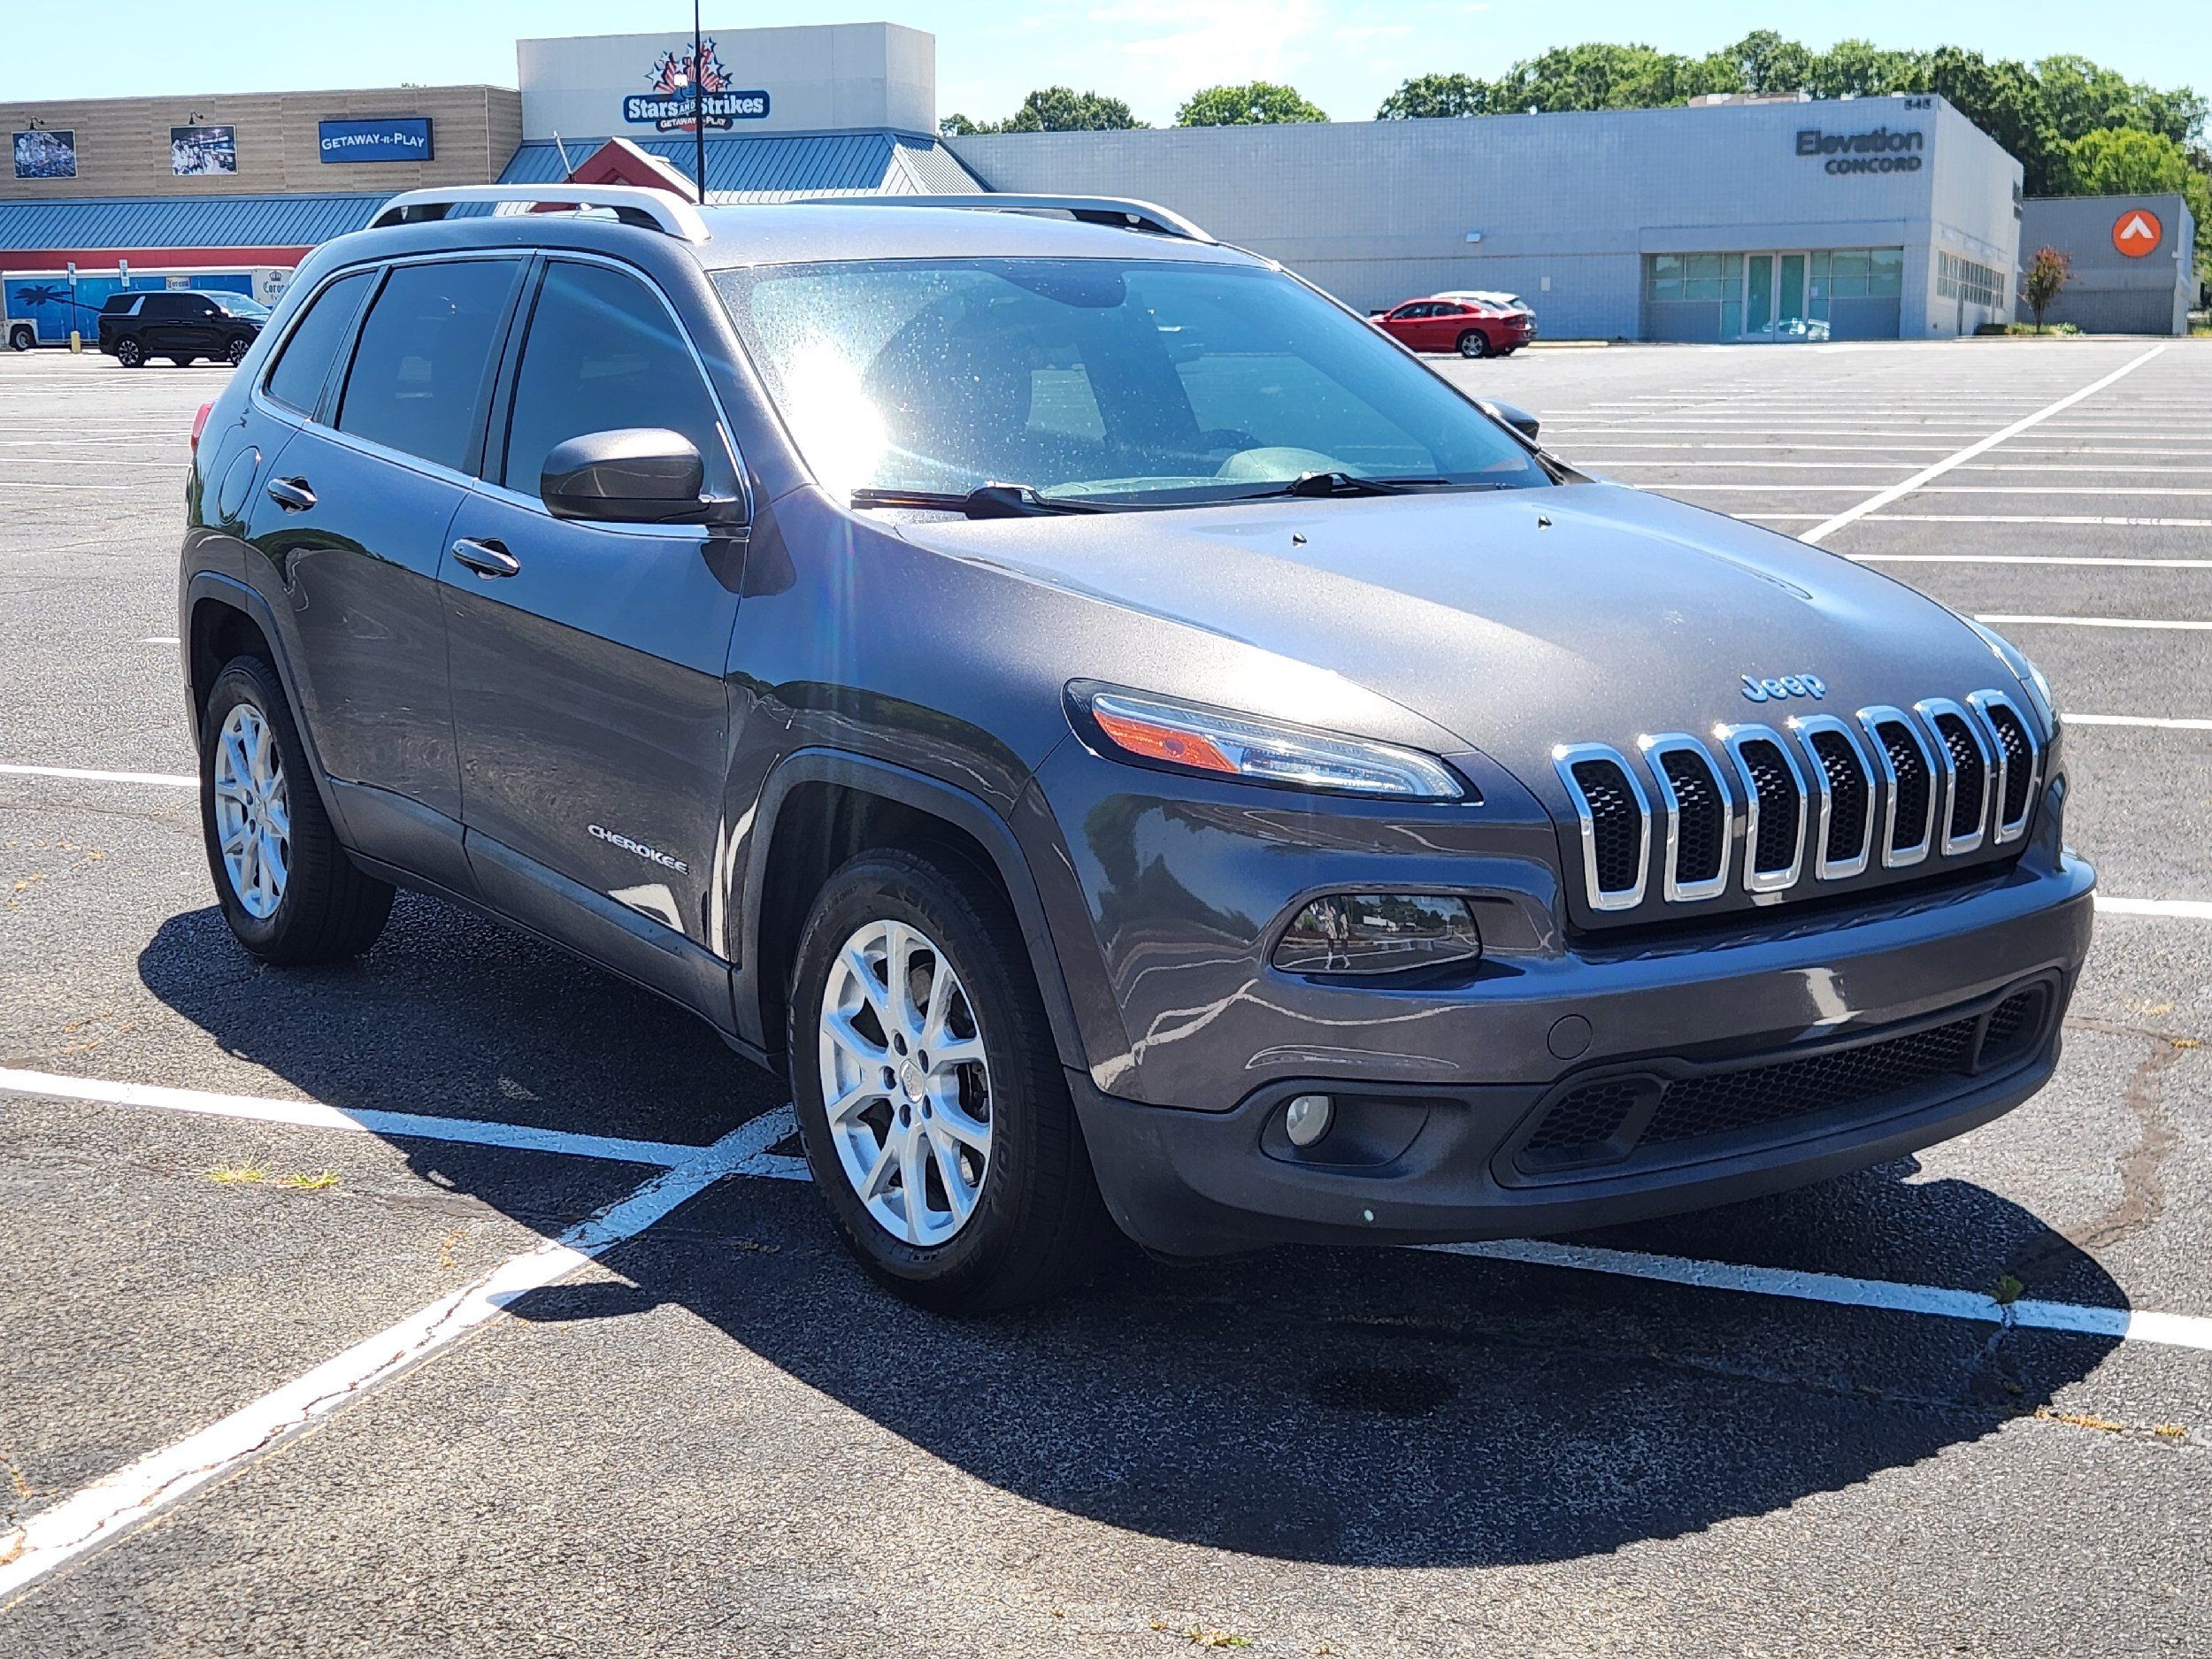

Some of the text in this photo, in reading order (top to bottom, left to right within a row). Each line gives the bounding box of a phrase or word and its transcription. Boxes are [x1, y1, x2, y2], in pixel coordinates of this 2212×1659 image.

[628, 94, 764, 119] Stars AND Strikes
[1796, 126, 1924, 156] Elevation
[1824, 157, 1923, 175] CONCORD
[1740, 674, 1826, 703] Jeep
[588, 824, 689, 876] CHEROKEE
